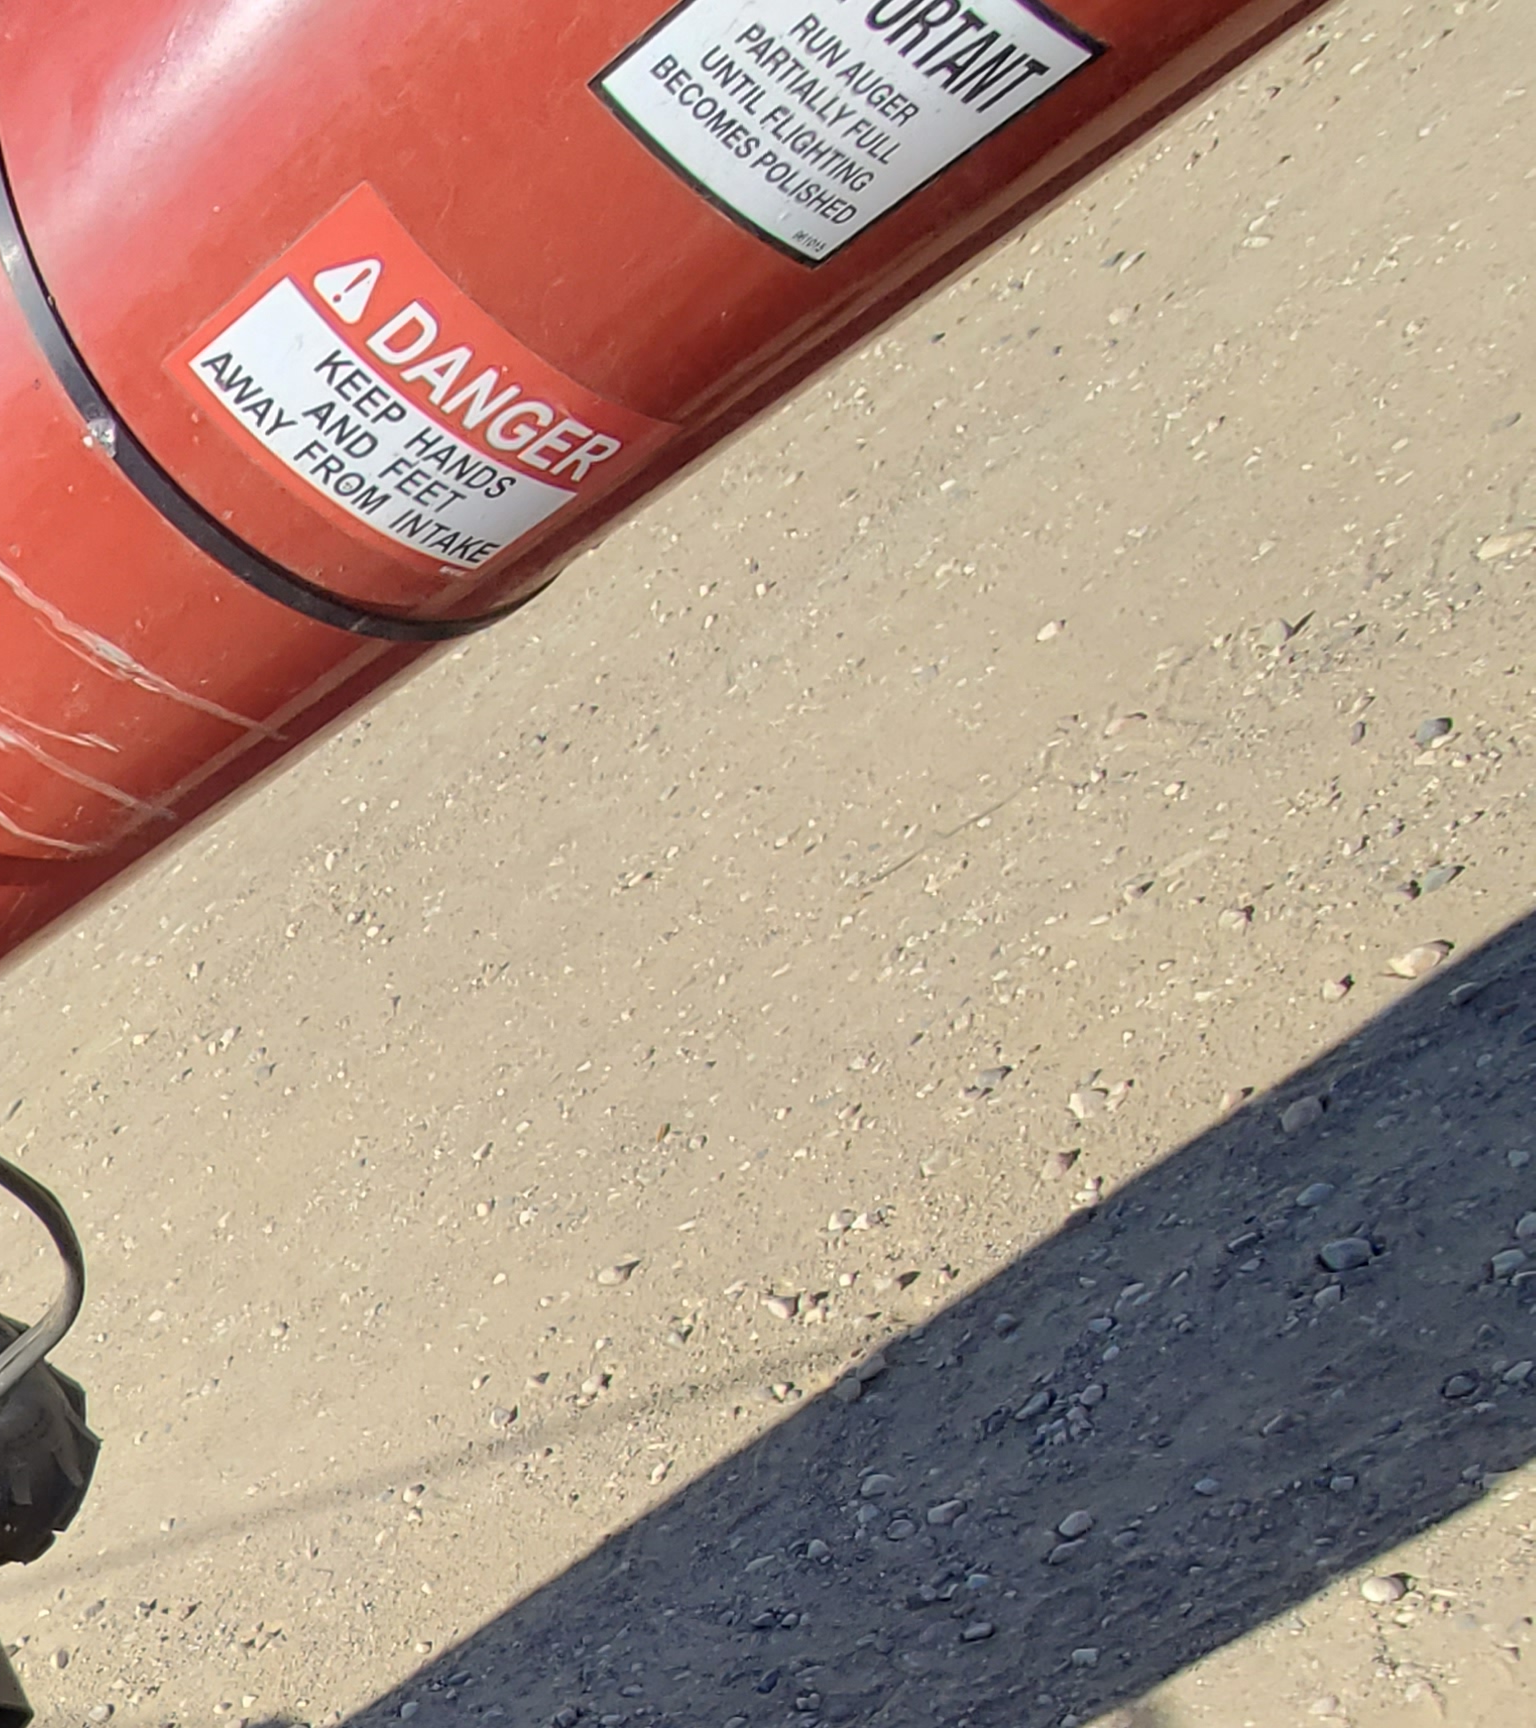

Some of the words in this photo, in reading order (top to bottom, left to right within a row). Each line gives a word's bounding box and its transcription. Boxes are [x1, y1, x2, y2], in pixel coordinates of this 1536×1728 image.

[699, 44, 767, 115] UNTIL
[759, 103, 875, 192] FLIGHTING
[734, 22, 857, 128] PARTIALLY
[840, 117, 901, 165] FULL
[789, 12, 851, 69] RUN
[835, 60, 920, 127] AUGER
[839, 0, 1050, 113] ORTANT
[649, 54, 761, 159] BECOMES
[749, 149, 858, 225] POLISHED
[200, 351, 298, 436] AWAY
[293, 439, 391, 515] FROM
[388, 508, 502, 564] INTAKE
[302, 400, 379, 459] AND
[377, 456, 467, 513] FEET
[313, 349, 407, 425] KEEP
[403, 425, 517, 498] HANDS
[365, 300, 622, 482] DANGER
